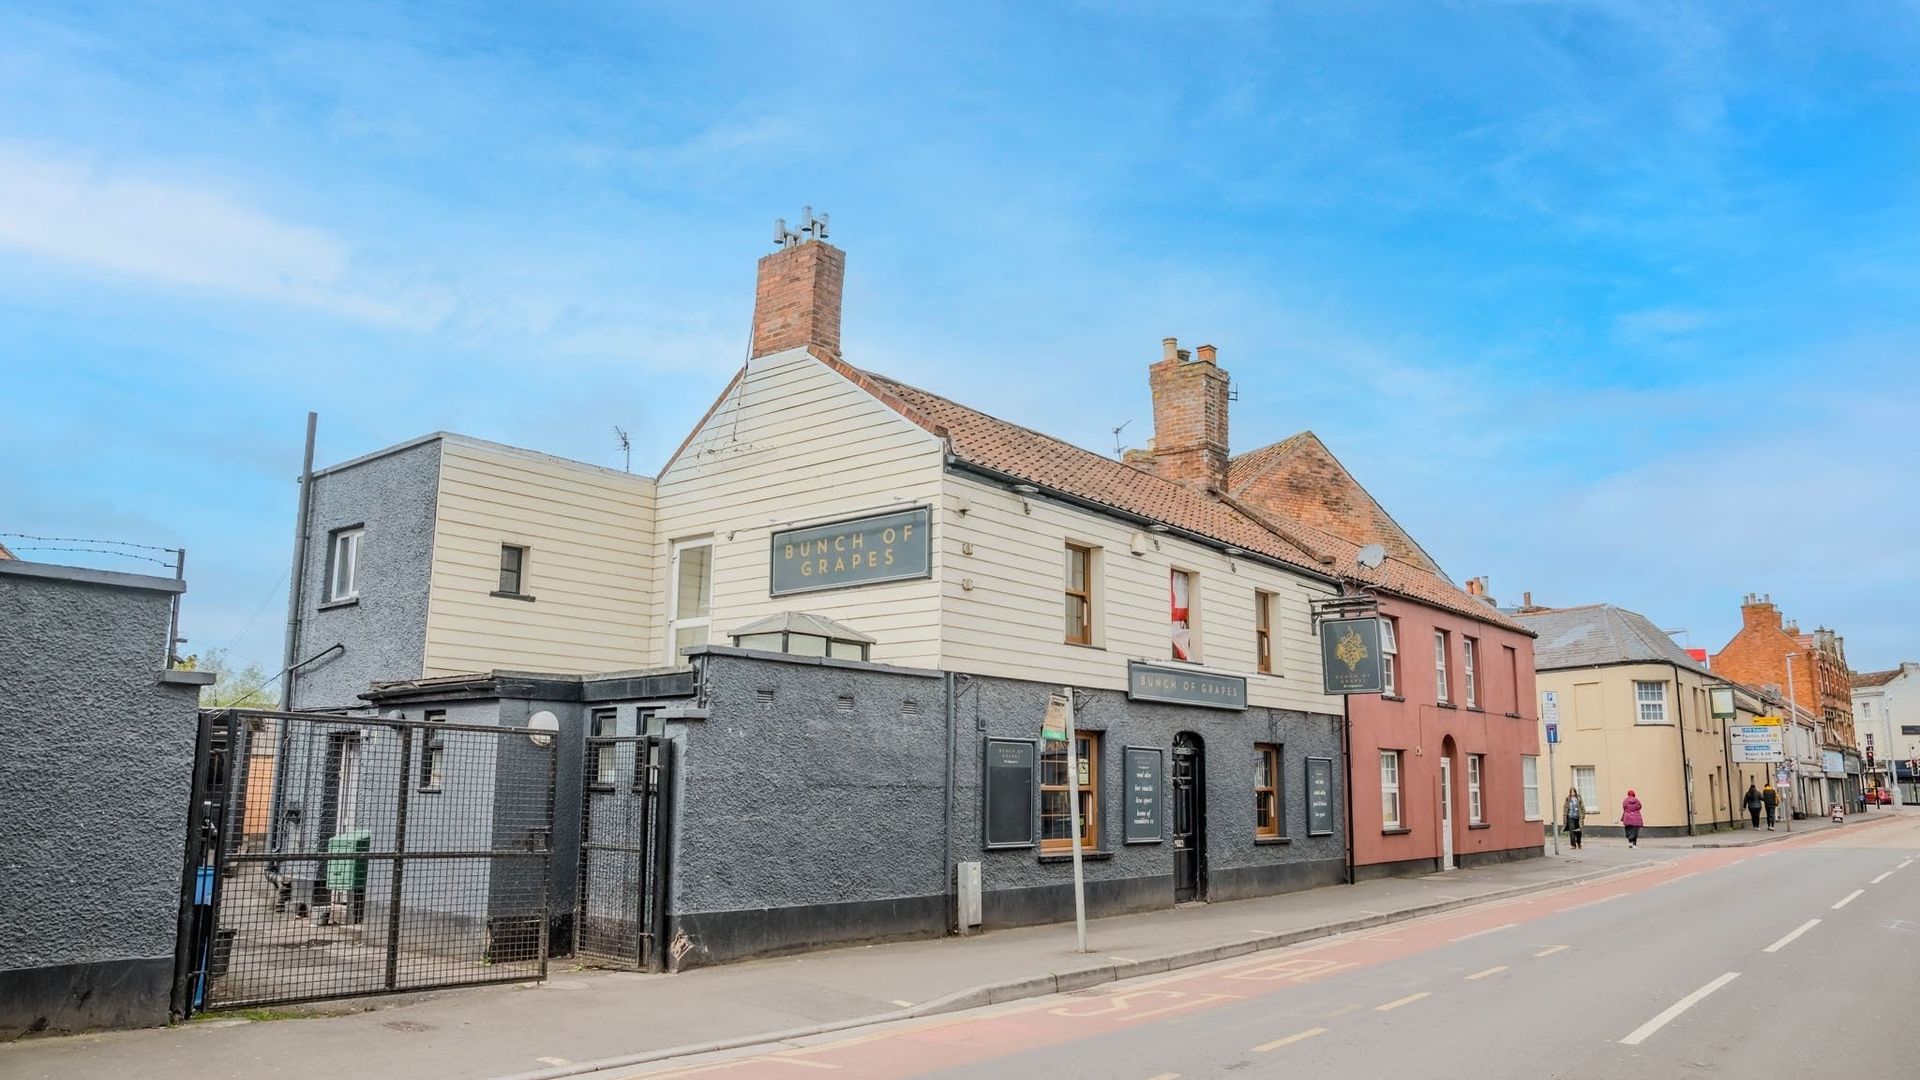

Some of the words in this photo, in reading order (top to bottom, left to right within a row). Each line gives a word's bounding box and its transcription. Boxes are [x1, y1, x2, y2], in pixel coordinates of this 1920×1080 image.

[785, 532, 864, 560] BUNCH
[882, 524, 913, 545] OF
[801, 549, 894, 576] GRAPES
[1140, 675, 1177, 689] BUNCH
[1183, 681, 1196, 691] OF
[1201, 684, 1238, 697] GRAPES
